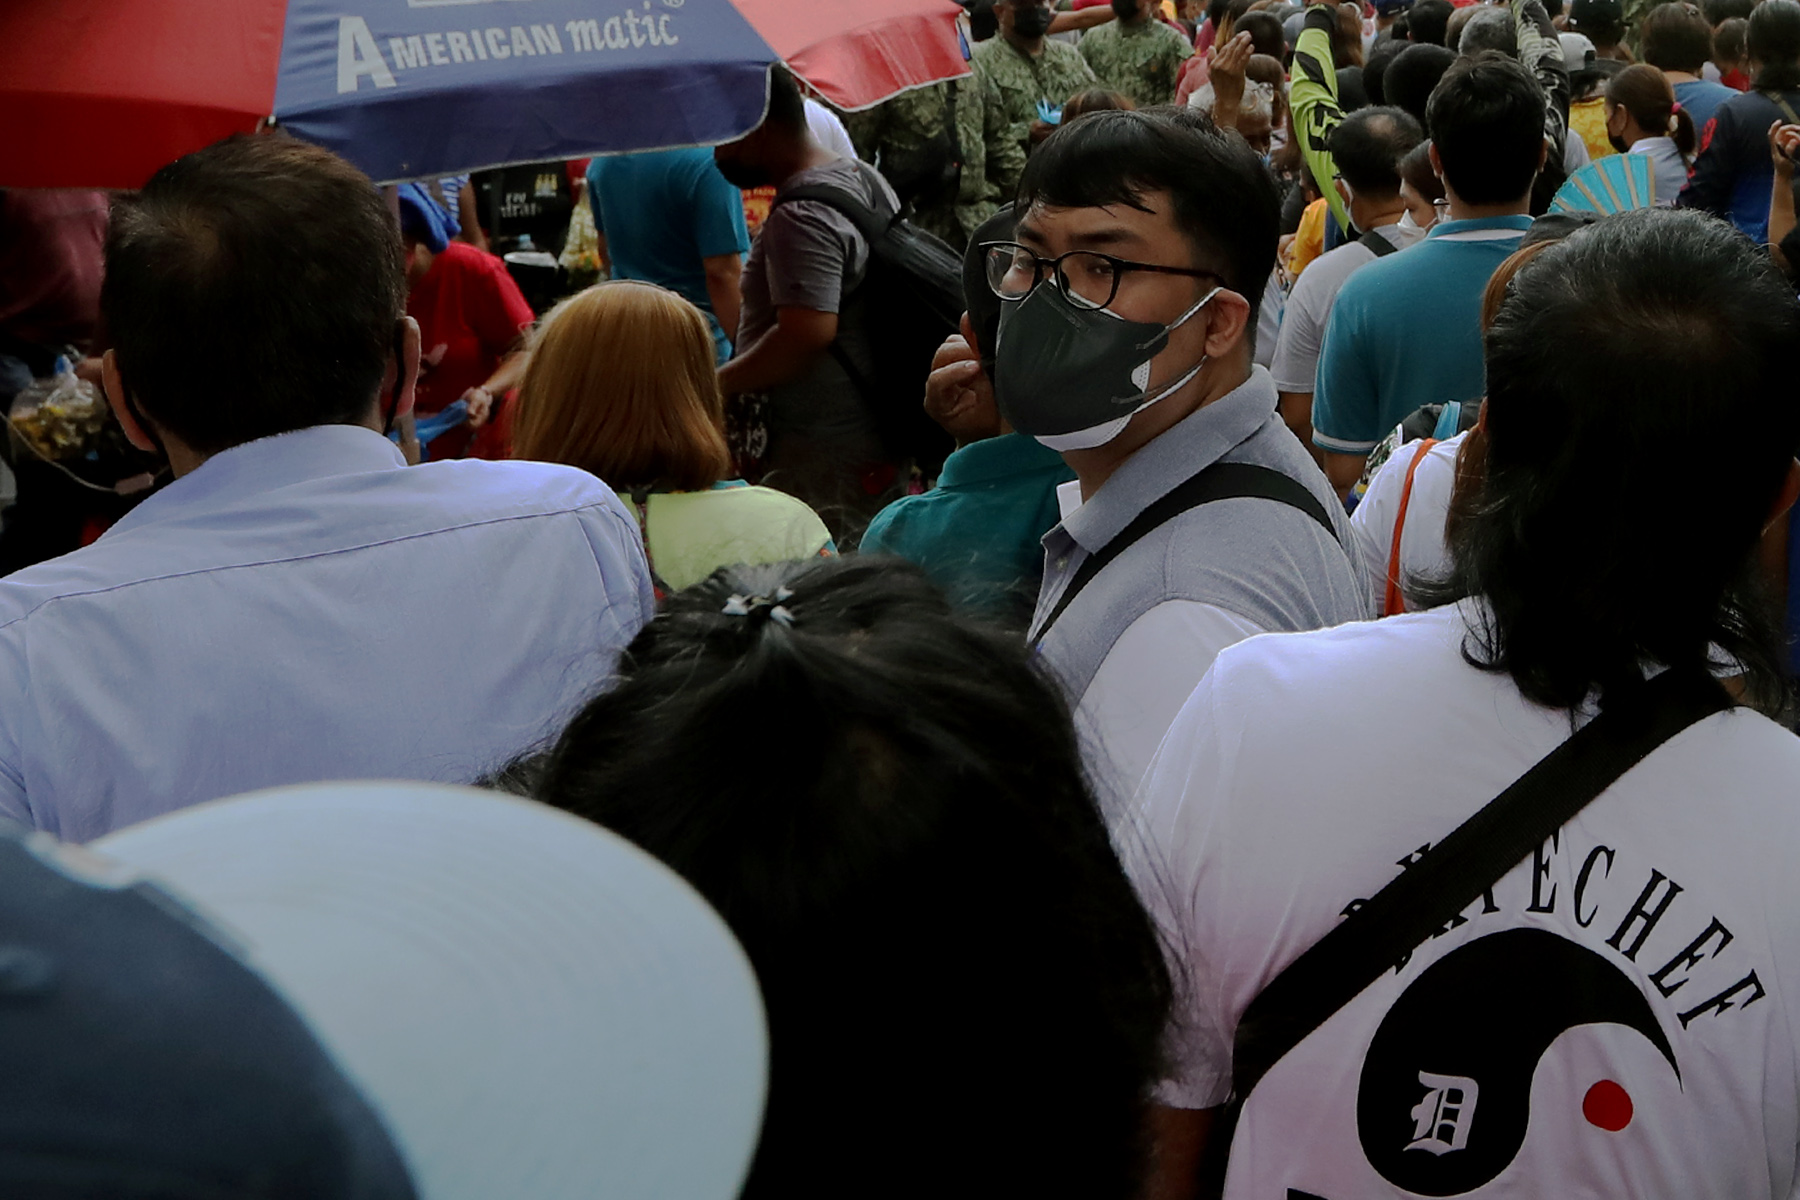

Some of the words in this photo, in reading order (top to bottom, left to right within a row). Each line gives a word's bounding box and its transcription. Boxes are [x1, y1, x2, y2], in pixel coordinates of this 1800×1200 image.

[337, 16, 563, 94] AMERICAN
[566, 1, 680, 53] matic
[1340, 827, 1767, 1030] ECHEF
[1402, 1069, 1479, 1157] D
